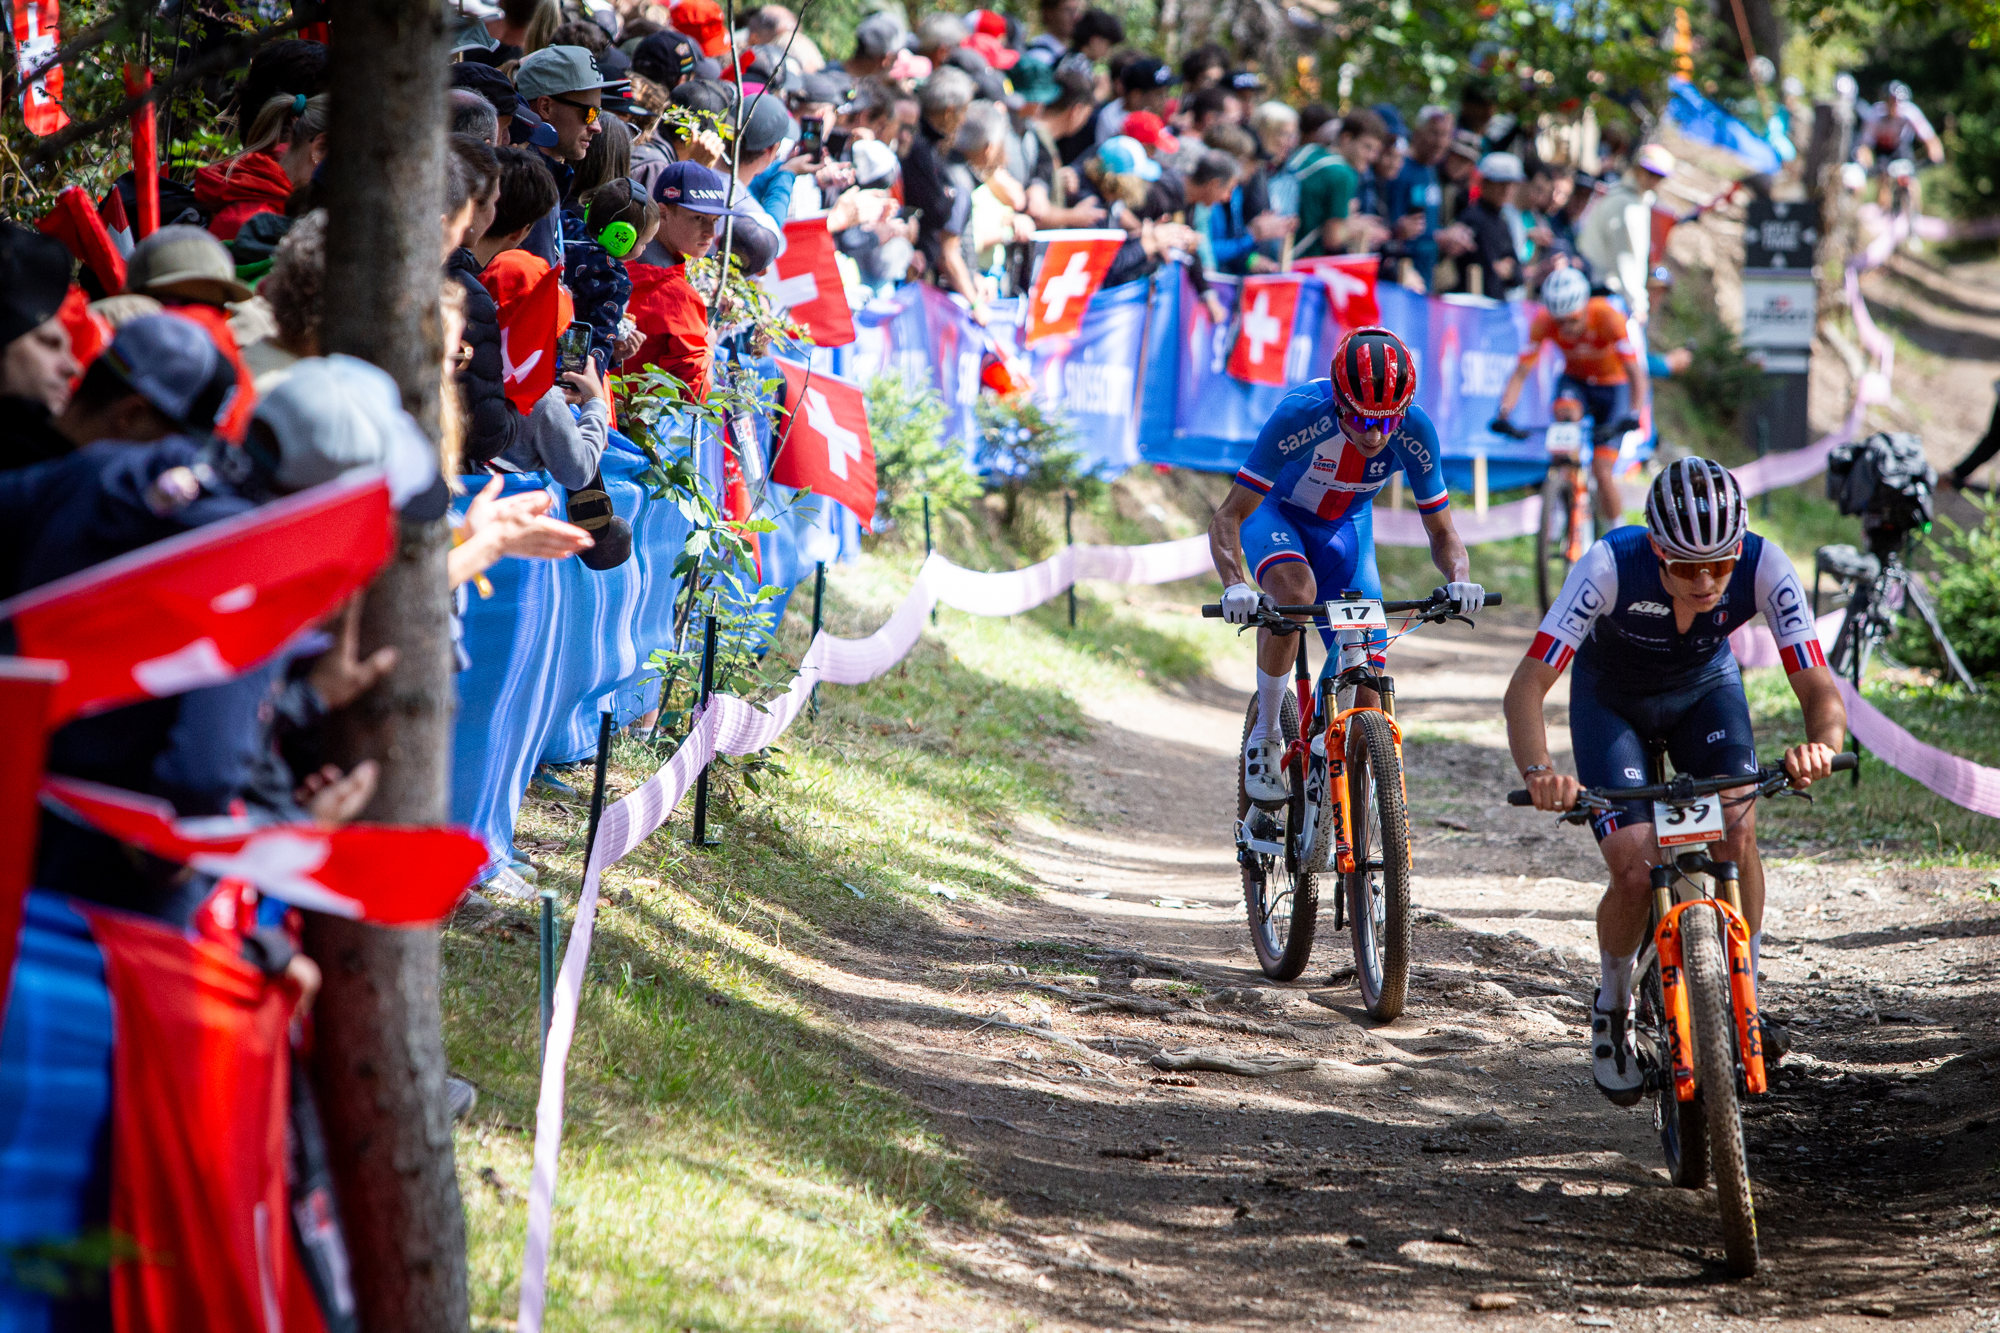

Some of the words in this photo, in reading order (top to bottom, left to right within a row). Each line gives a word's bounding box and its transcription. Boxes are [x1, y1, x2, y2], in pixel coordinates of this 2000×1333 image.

[689, 189, 725, 201] CANY
[1277, 415, 1334, 456] sazka
[1341, 606, 1371, 620] 17
[1566, 589, 1598, 633] CIC
[1627, 600, 1671, 616] KTM
[1777, 587, 1802, 628] CIC
[1332, 801, 1345, 842] FOX
[1665, 804, 1710, 825] 39
[1667, 1016, 1682, 1065] FOX
[1745, 1007, 1762, 1057] FOX
